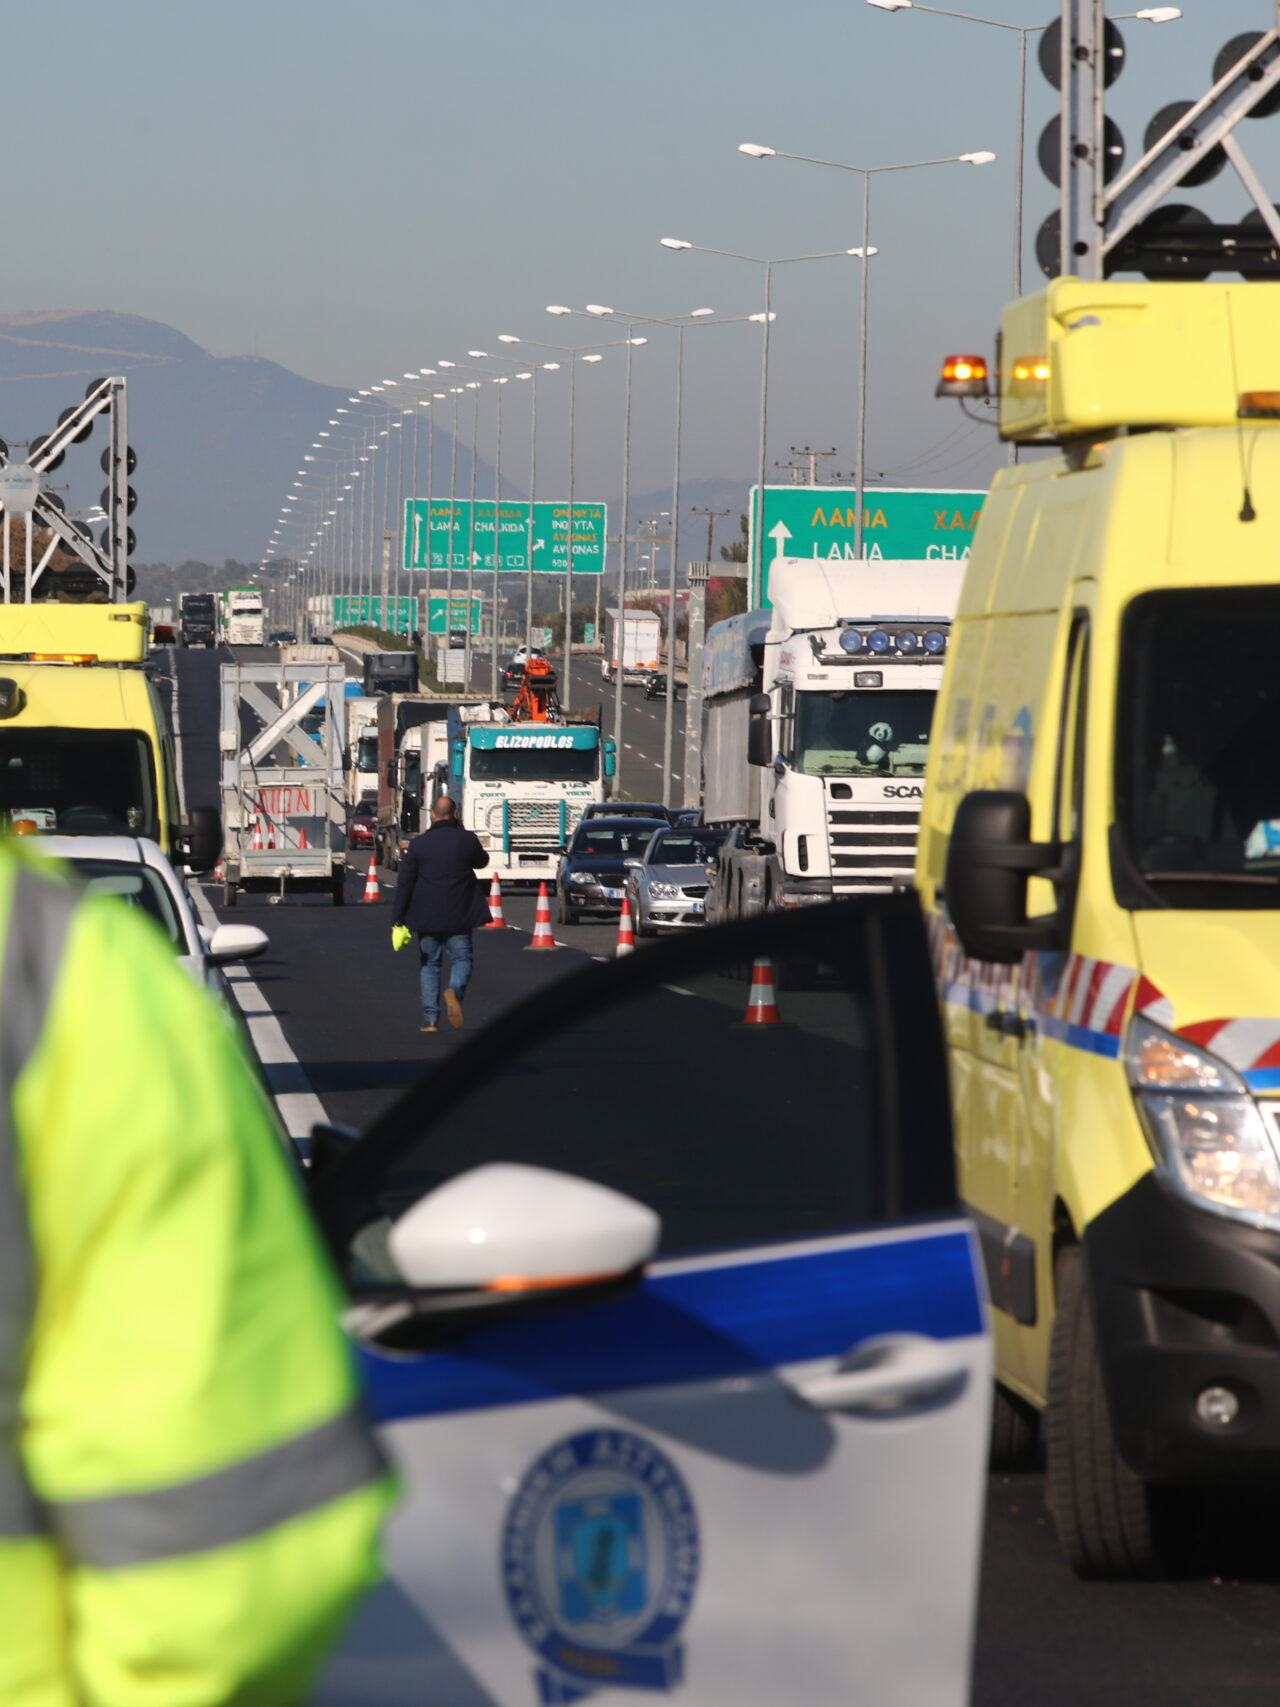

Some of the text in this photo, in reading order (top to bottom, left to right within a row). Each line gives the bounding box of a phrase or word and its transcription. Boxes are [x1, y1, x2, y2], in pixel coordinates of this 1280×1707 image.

[430, 521, 460, 531] LAMA
[552, 544, 600, 555] AVONAS
[495, 736, 574, 749] ELIZOPOULOS
